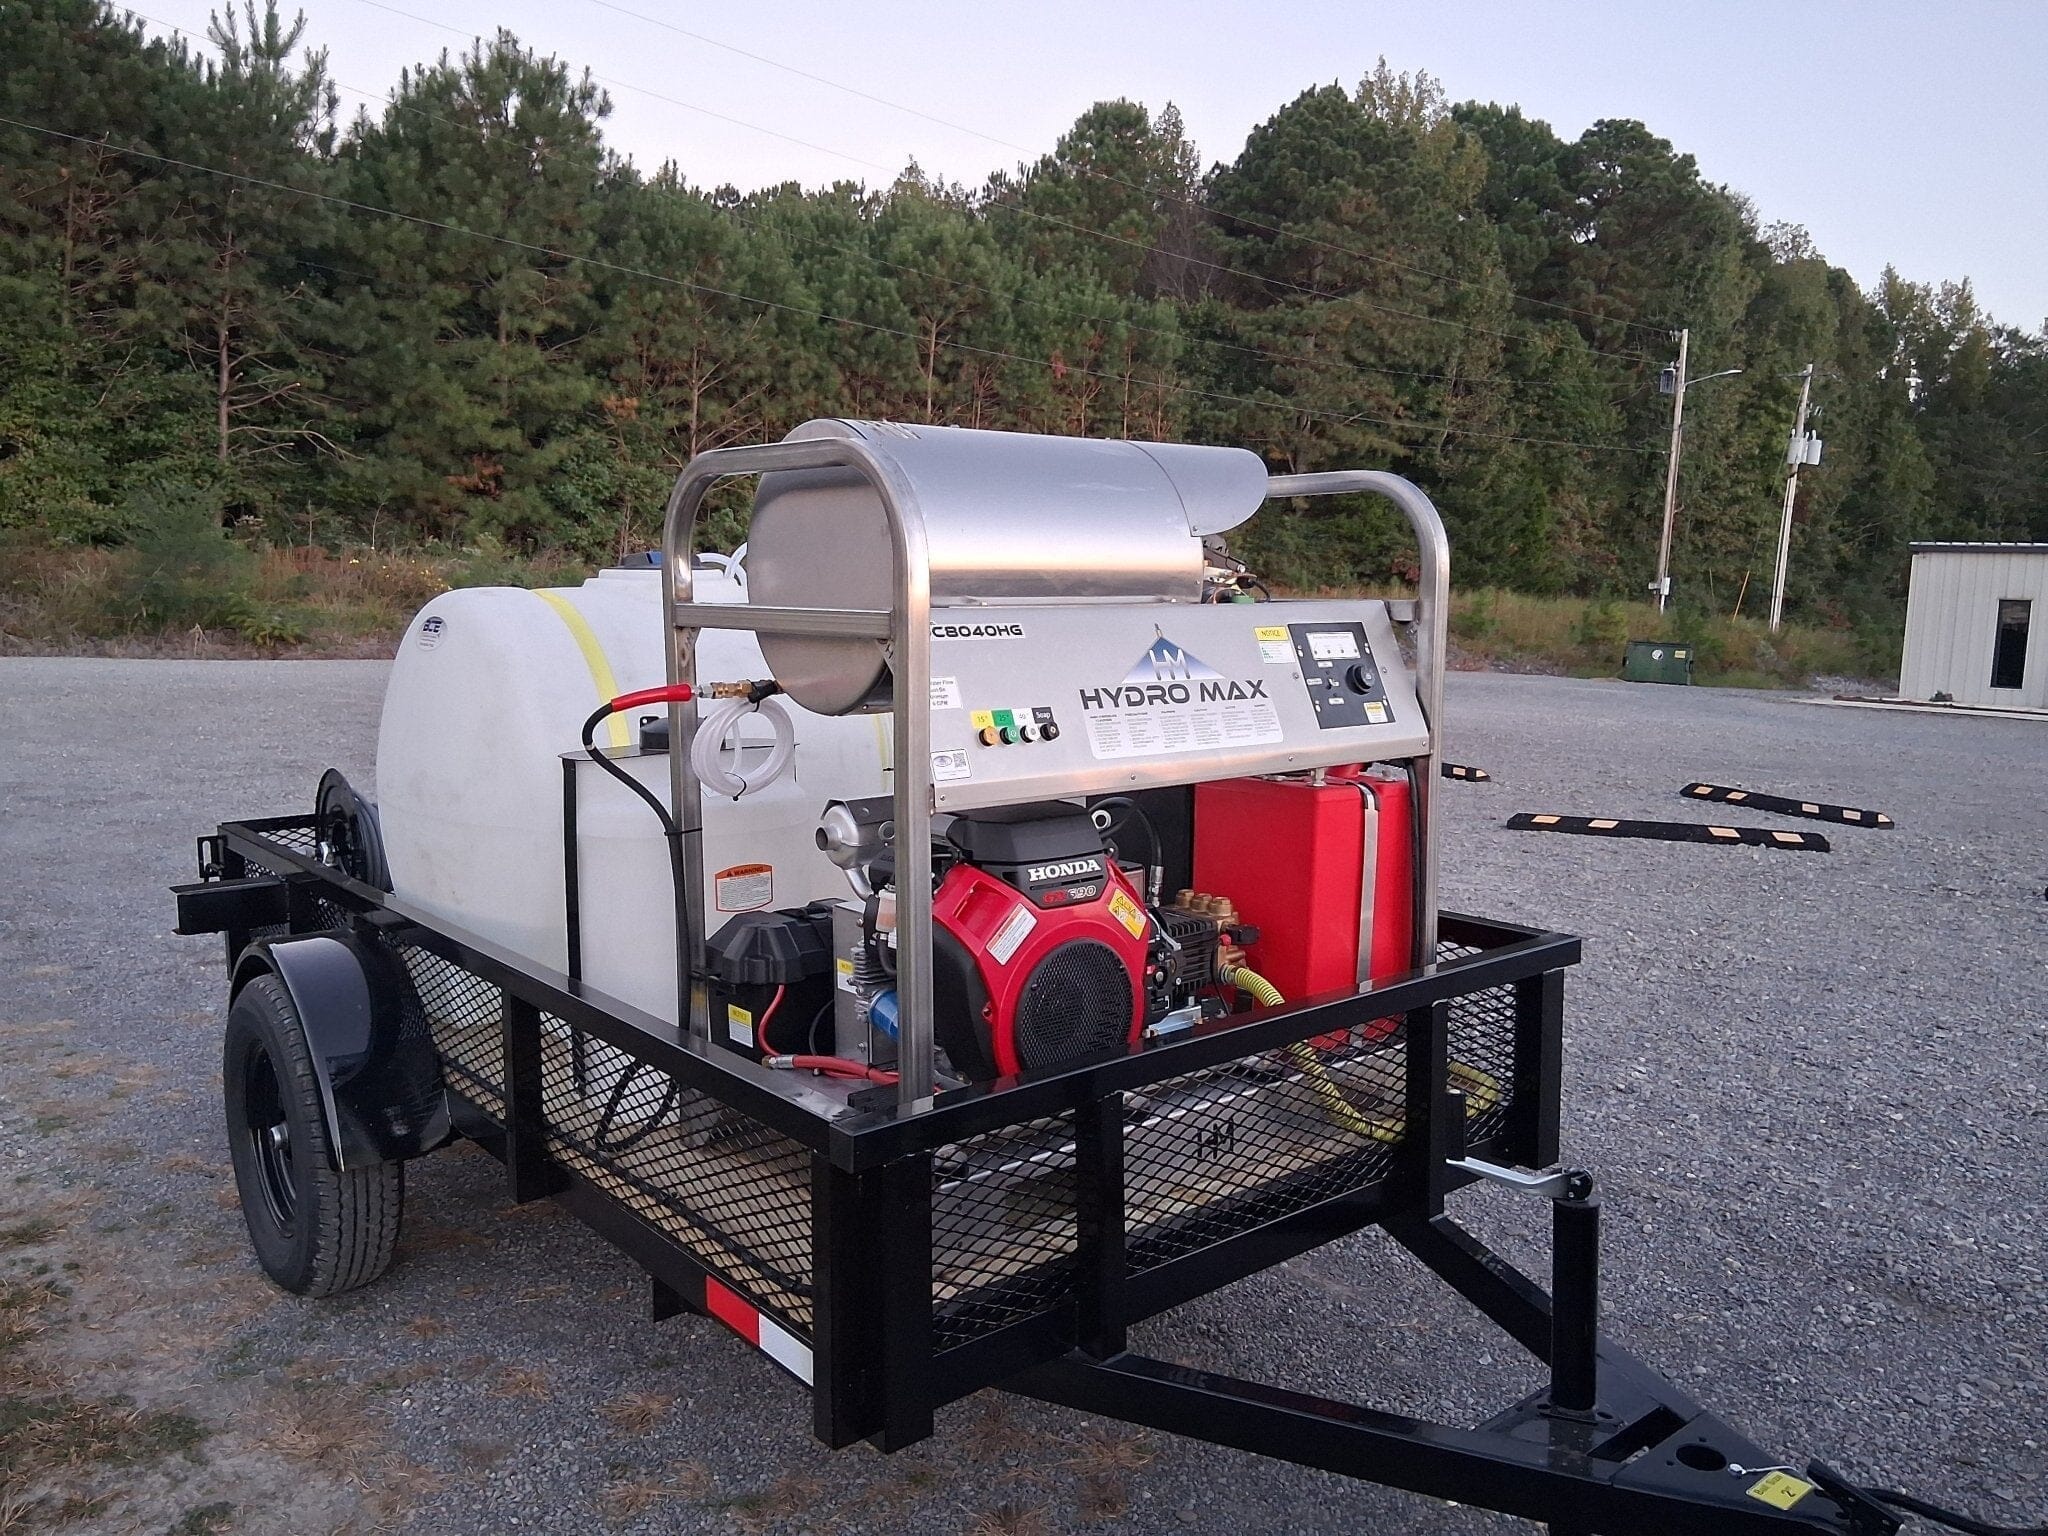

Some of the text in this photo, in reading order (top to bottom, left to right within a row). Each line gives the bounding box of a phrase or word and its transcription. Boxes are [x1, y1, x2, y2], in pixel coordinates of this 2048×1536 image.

[1079, 679, 1269, 710] HYDRO MAX
[733, 867, 764, 876] WARNING
[1027, 859, 1102, 882] HONDA
